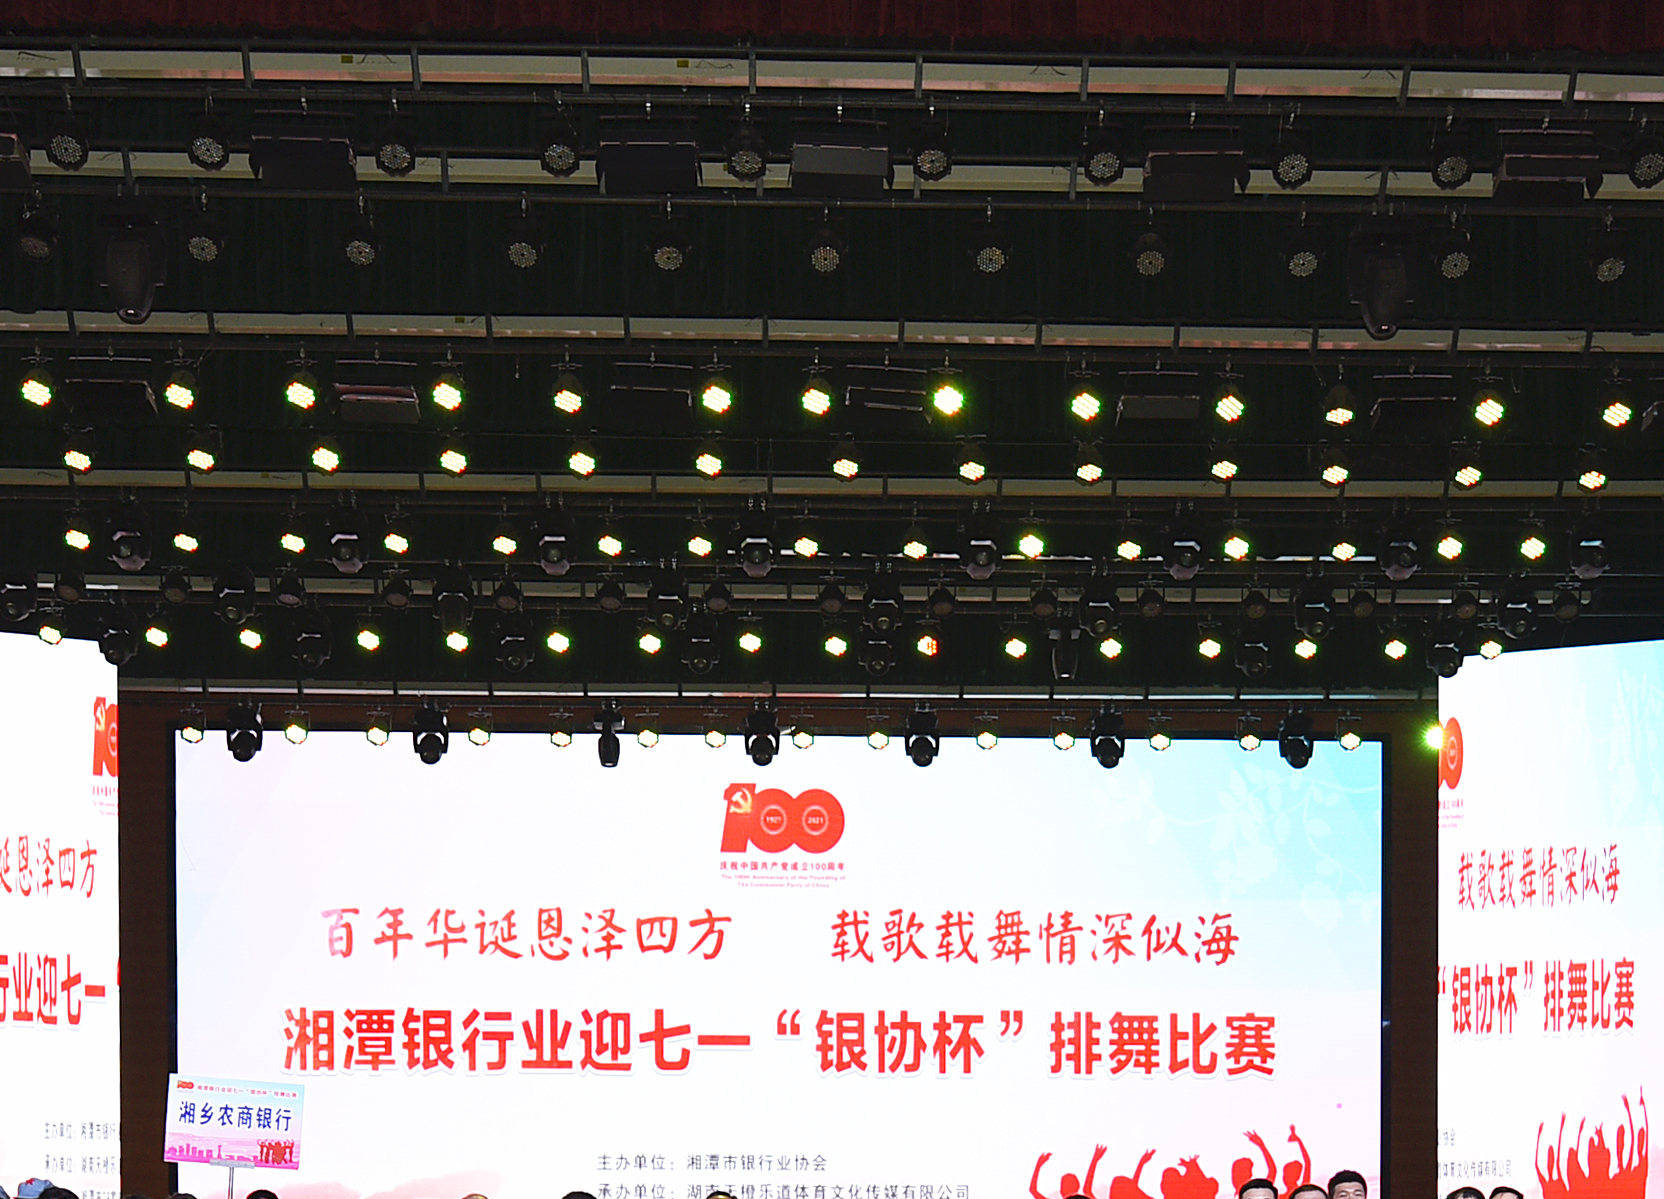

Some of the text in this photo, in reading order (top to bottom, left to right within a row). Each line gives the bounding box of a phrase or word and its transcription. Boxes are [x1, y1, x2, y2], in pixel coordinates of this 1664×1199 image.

[720, 783, 845, 854] 100
[1458, 844, 1620, 911] 载歌载舞情深似海
[322, 905, 1240, 967] 百年华诞恩泽四方 载歌载舞情深似海
[179, 1100, 292, 1131] 湘乡农商银行
